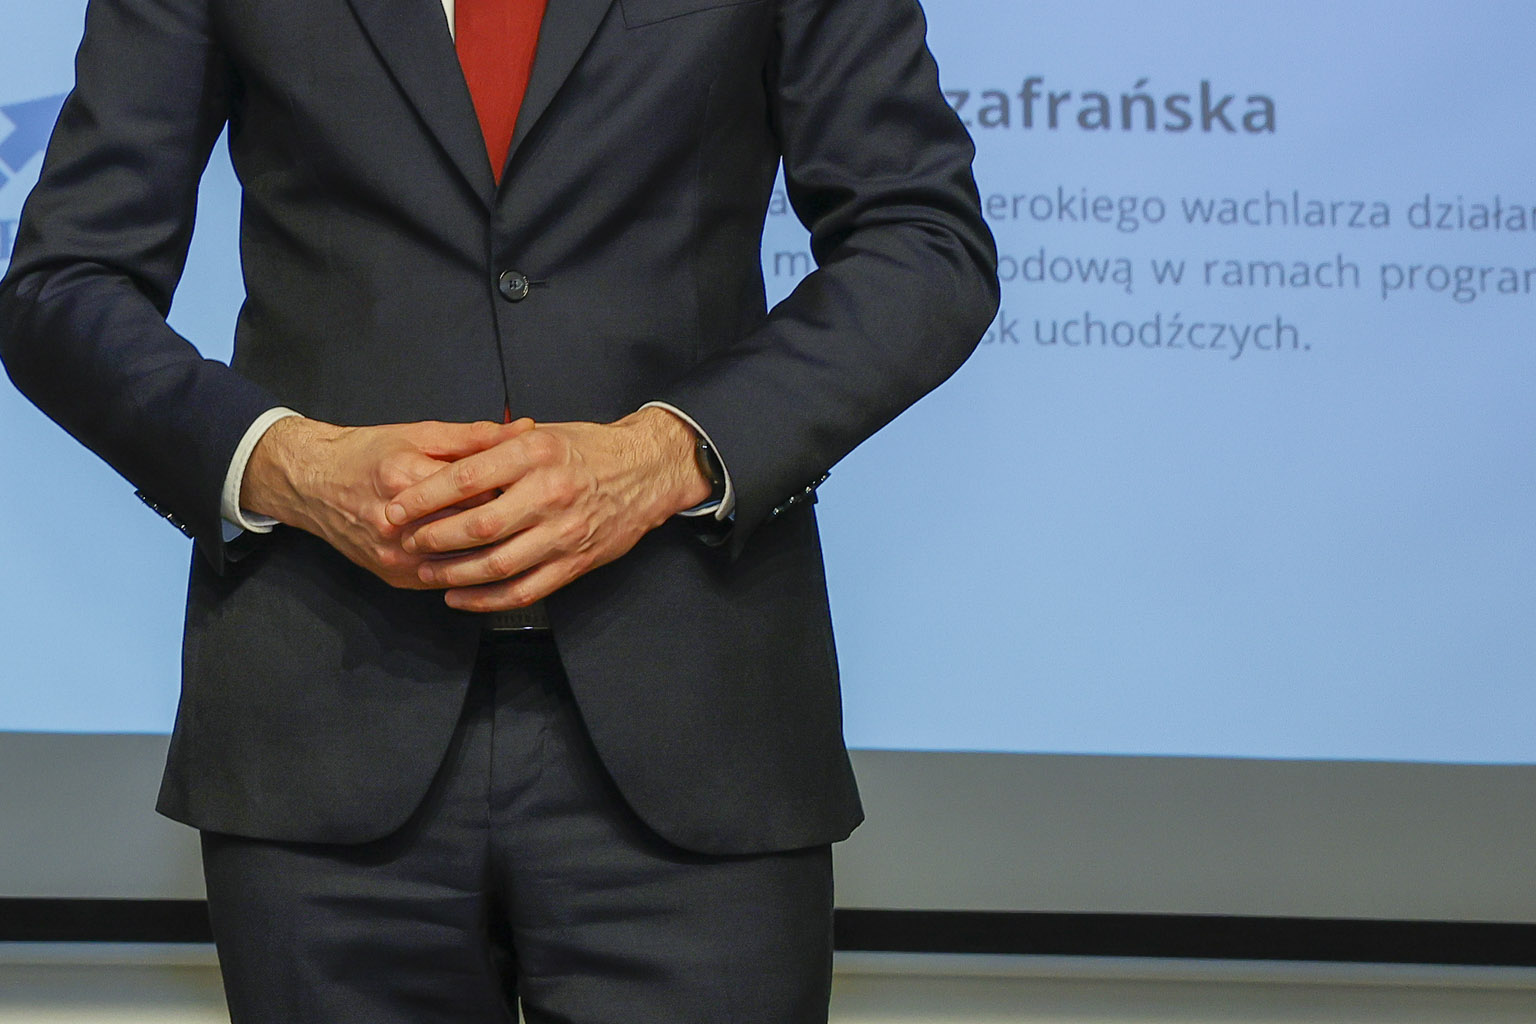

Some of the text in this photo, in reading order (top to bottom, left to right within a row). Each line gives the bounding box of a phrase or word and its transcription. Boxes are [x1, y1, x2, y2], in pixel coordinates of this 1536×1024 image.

[944, 76, 1279, 134] zafrańska
[984, 185, 1167, 234] erokiego
[1180, 189, 1391, 228] wachlarza
[1150, 258, 1185, 285] w
[1203, 252, 1361, 289] ramach
[1034, 310, 1312, 361] uchodźczych.
